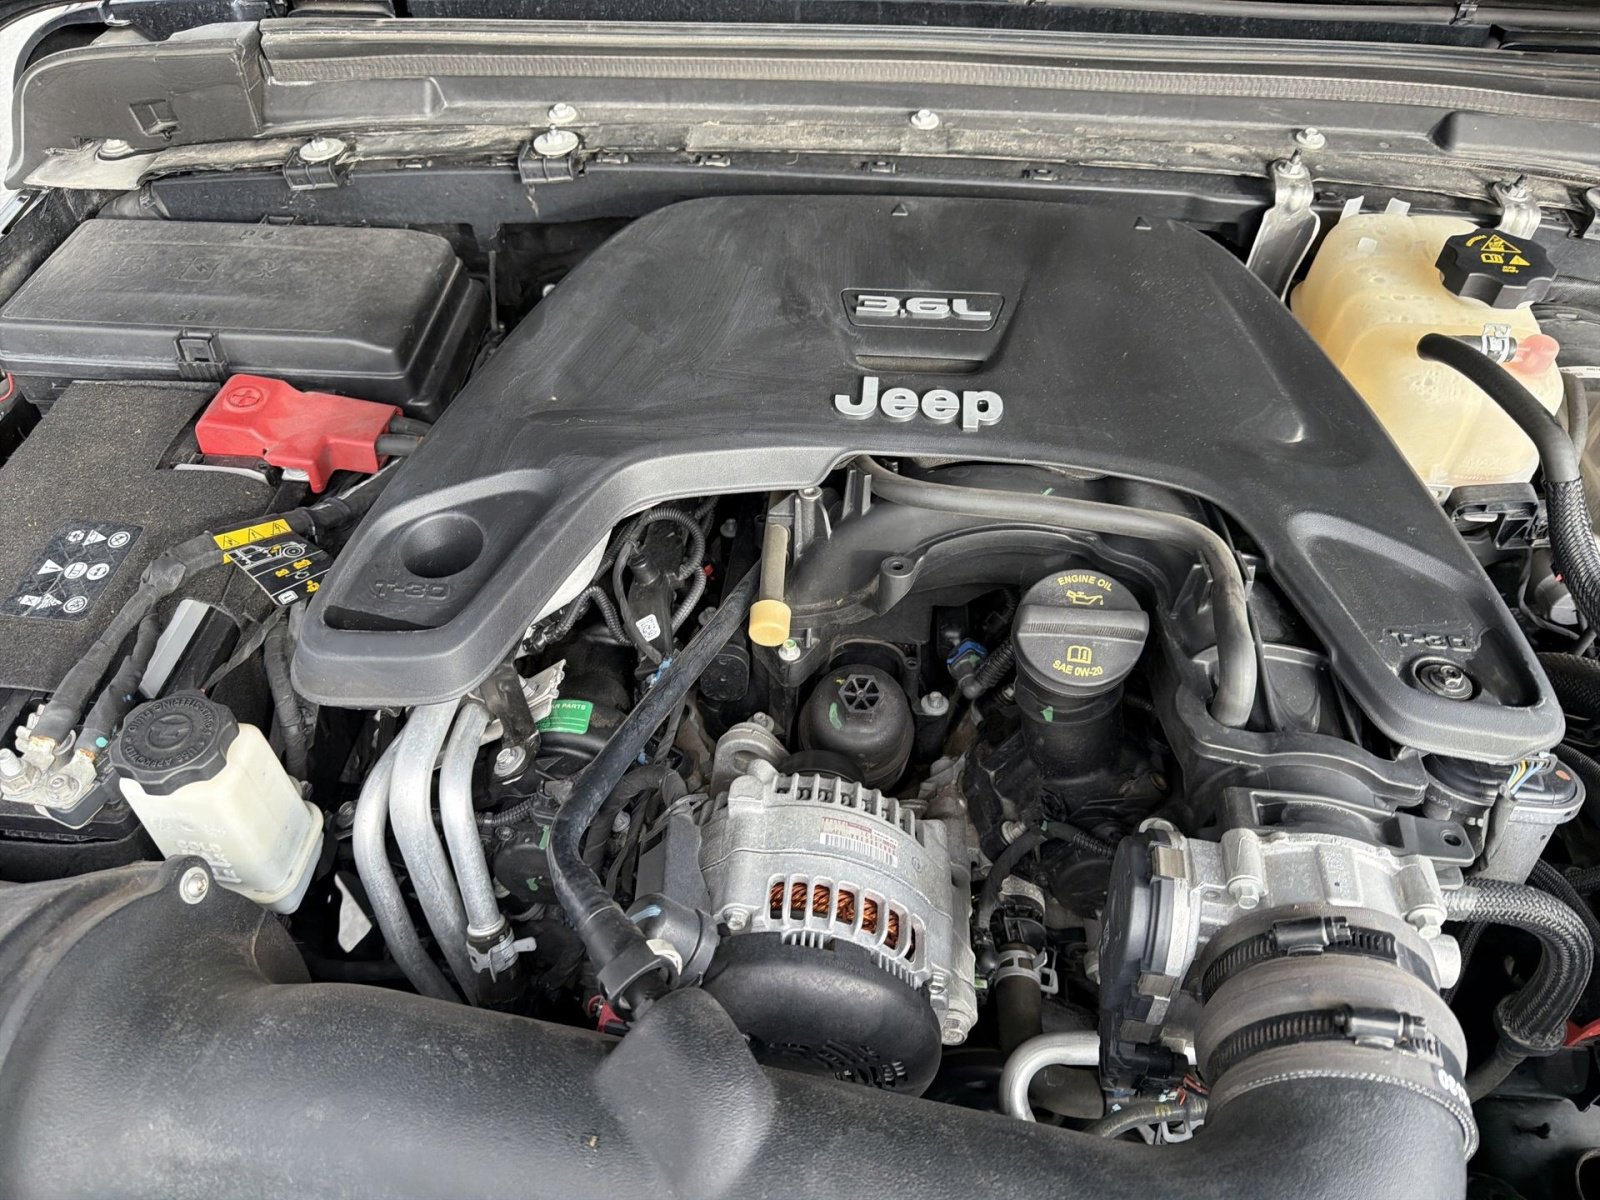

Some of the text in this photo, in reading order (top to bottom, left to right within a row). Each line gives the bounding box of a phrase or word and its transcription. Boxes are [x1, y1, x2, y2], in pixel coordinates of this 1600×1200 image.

[855, 294, 992, 321] 3.6L
[834, 376, 1004, 433] Jeep
[1057, 574, 1113, 592] ENGINE OIL
[1052, 659, 1104, 677] SAE 0W-20
[561, 703, 586, 711] PARTS
